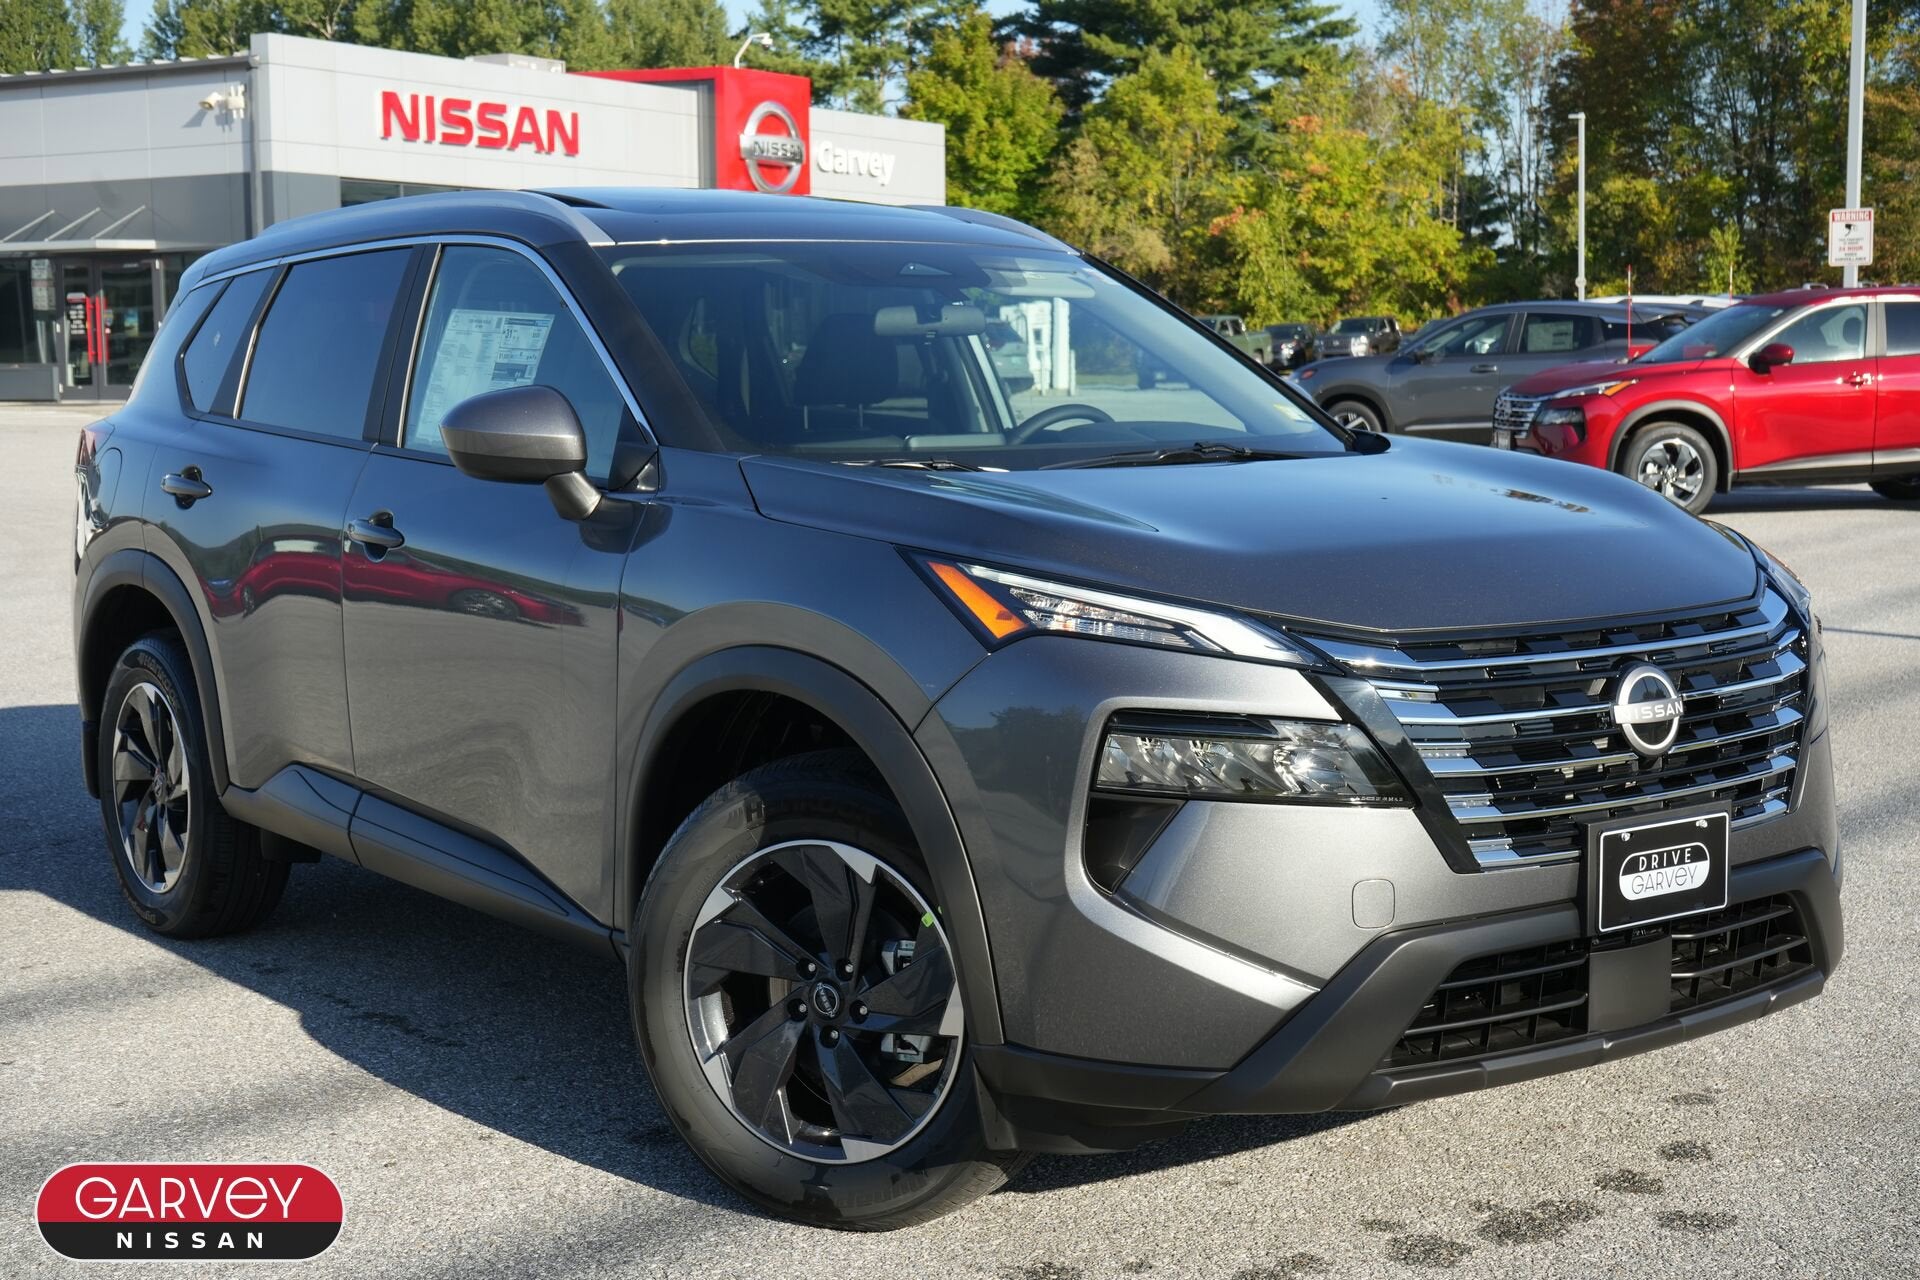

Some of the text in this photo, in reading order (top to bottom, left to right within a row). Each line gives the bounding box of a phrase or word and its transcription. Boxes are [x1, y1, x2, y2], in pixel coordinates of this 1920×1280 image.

[381, 90, 579, 156] NISSAN
[752, 139, 803, 163] NISSAN
[816, 140, 895, 186] Garvey
[1834, 211, 1869, 220] WARNING
[1620, 700, 1684, 720] NISSAN
[1638, 848, 1692, 871] DRIVE
